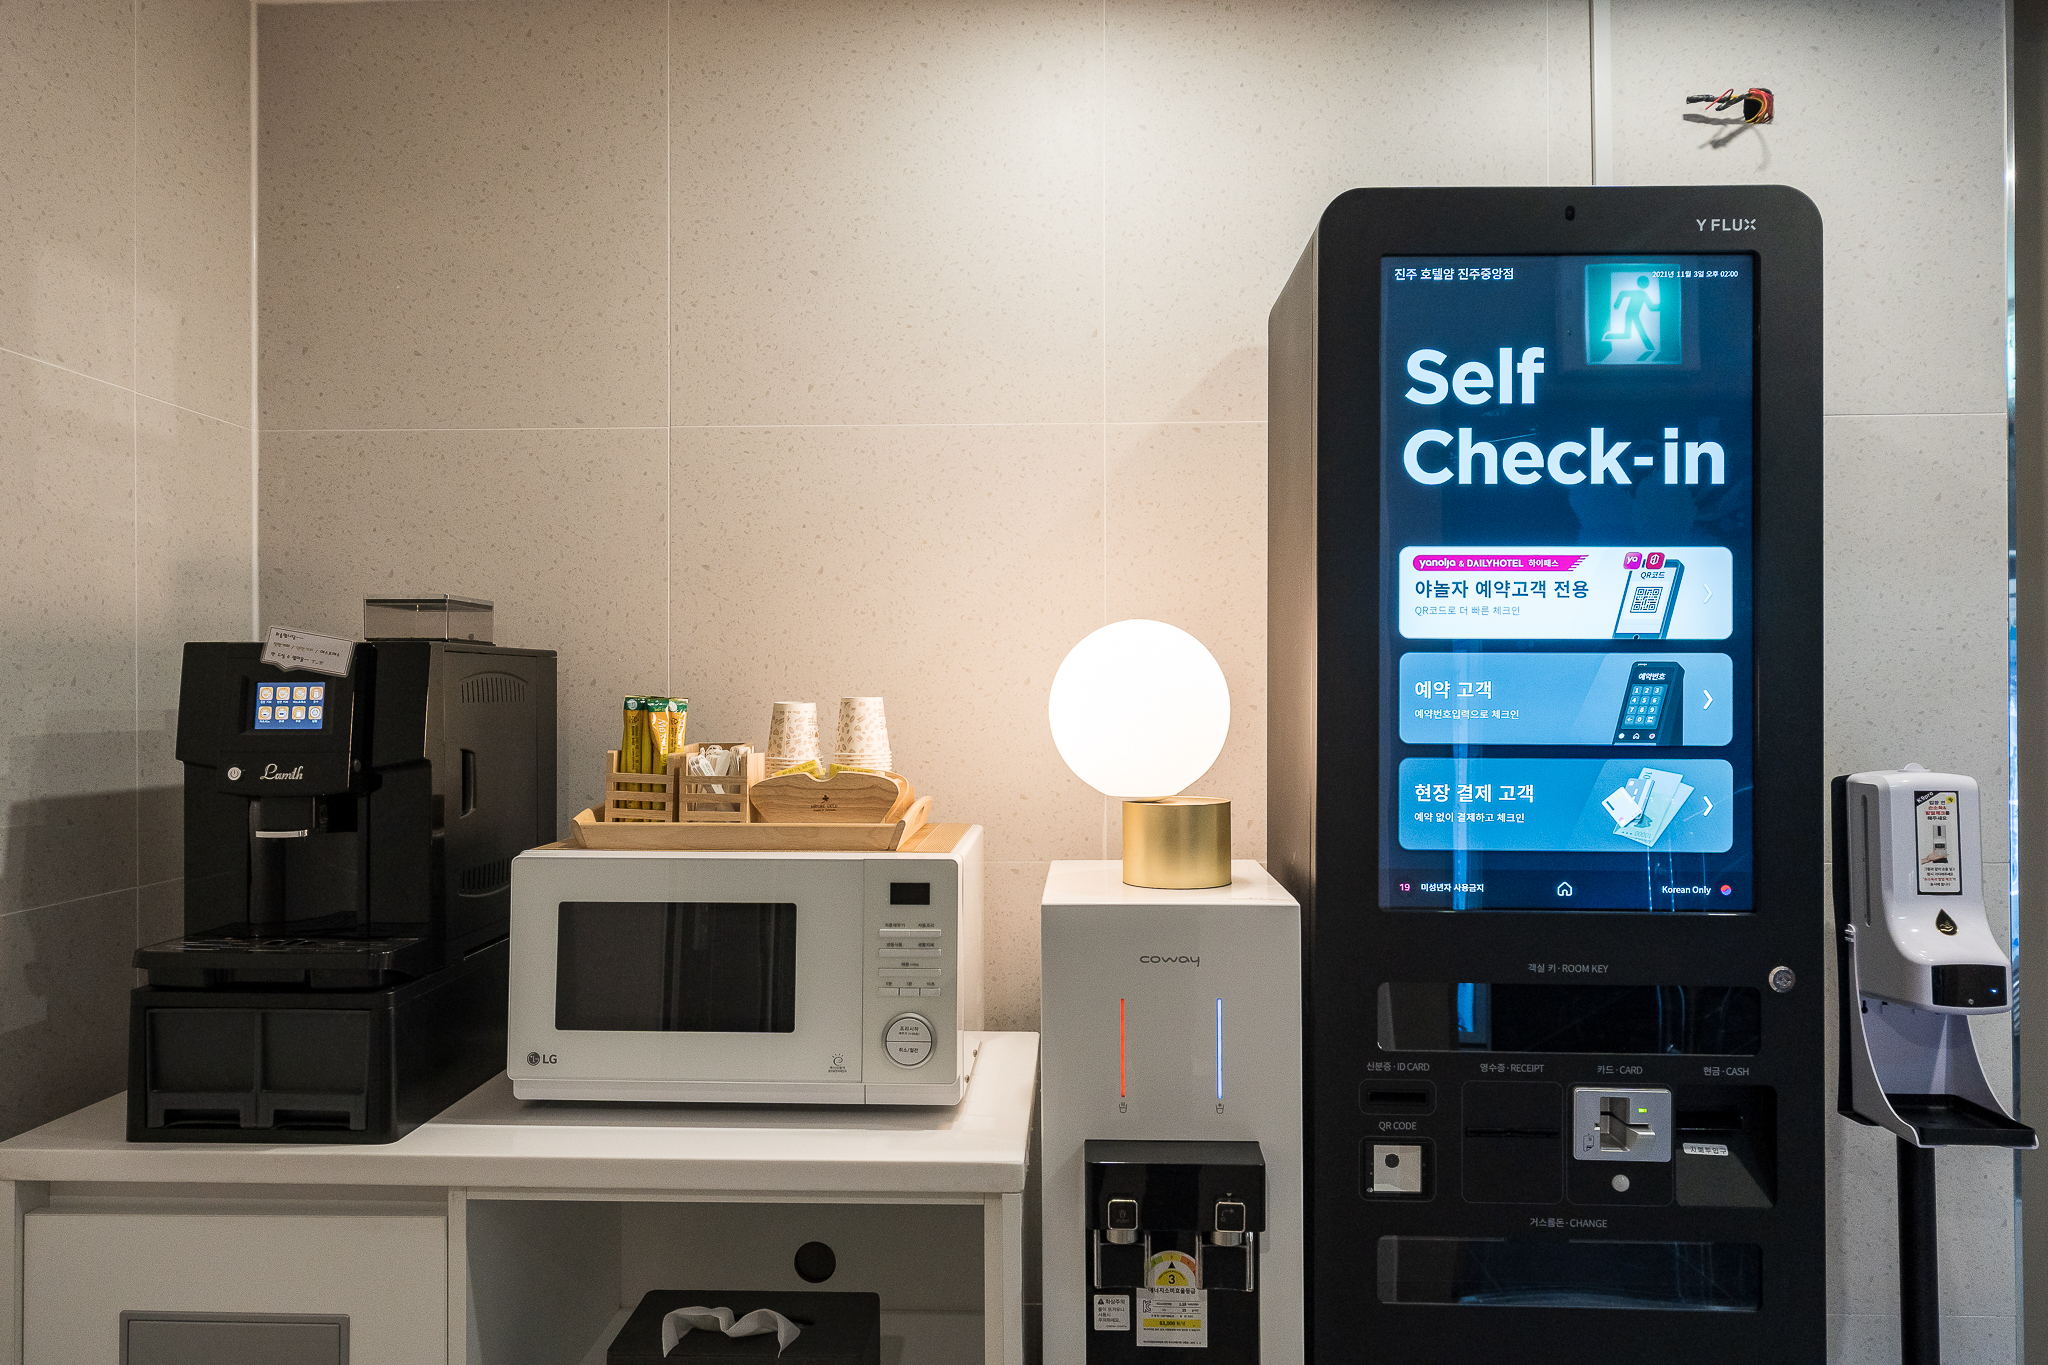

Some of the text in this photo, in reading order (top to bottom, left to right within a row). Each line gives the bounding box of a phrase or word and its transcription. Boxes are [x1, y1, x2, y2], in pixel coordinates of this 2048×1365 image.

[1394, 268, 1514, 280] 진주 호텔얌 진주중앙점
[1652, 270, 1674, 278] 2021년
[1405, 347, 1544, 405] Self
[1403, 427, 1725, 485] Check-in
[1419, 558, 1456, 569] yanolja
[1467, 559, 1524, 568] DAILYHOTEL
[1528, 559, 1559, 567] 하이패스
[1641, 572, 1665, 580] QR코드
[1415, 580, 1589, 598] 야놀자 예약고객 전용
[1415, 606, 1520, 615] QR코드로 더 빠른 체크인
[1415, 681, 1492, 700] 예약 고객
[1414, 709, 1519, 720] 예약번호입력으로 체크인
[1414, 784, 1534, 803] 현장 결제 고객
[1414, 812, 1525, 823] 예약 없이 결제하고 체크인
[1399, 883, 1411, 891] 19
[1421, 883, 1484, 892] 미성년자 사용금지
[1662, 886, 1711, 896] Korean Only
[1139, 955, 1200, 967] coway
[1528, 963, 1545, 973] 객실
[1592, 965, 1609, 973] KEY
[543, 1054, 557, 1064] LG
[1407, 1063, 1430, 1071] CARD
[1379, 1121, 1417, 1131] QR CODE
[1168, 1274, 1176, 1285] 3
